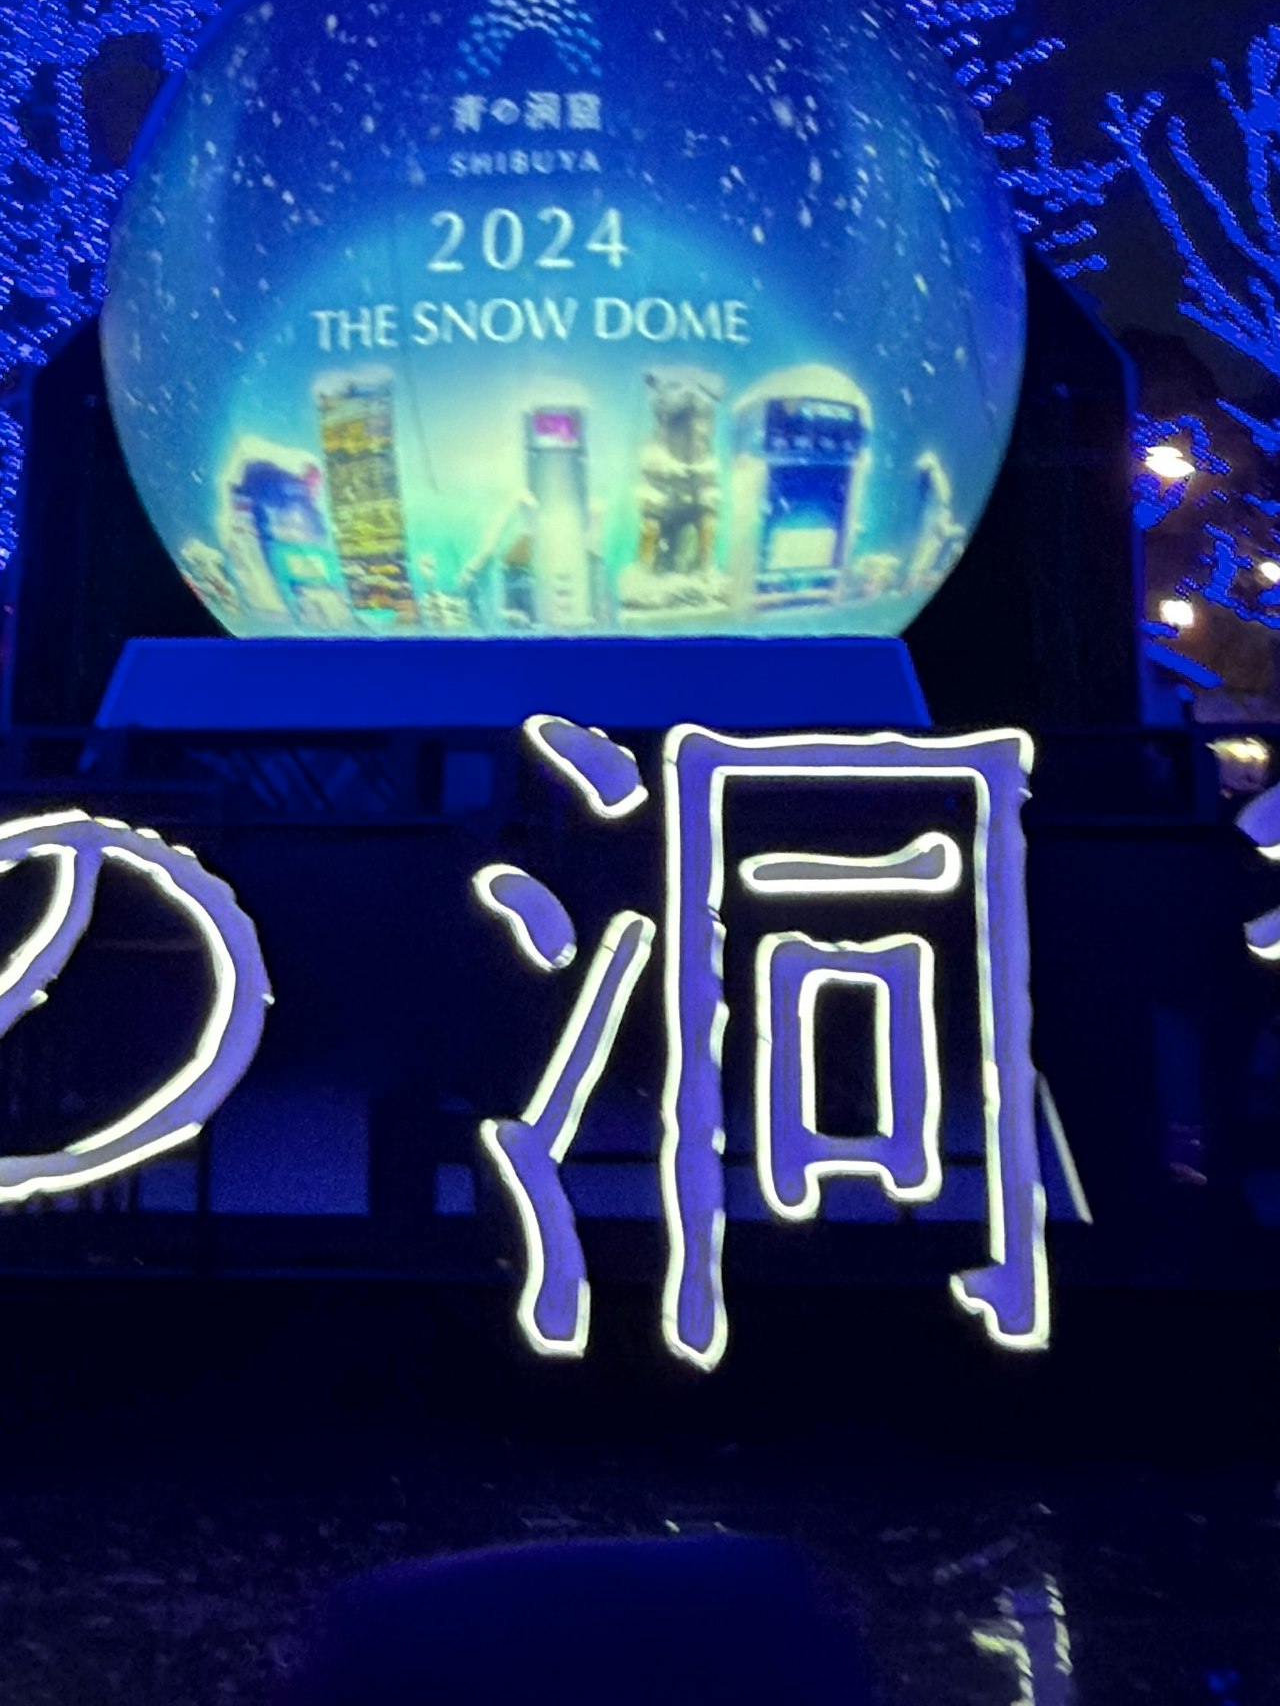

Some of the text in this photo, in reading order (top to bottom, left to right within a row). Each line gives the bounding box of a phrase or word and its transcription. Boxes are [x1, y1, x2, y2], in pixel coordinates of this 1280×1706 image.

[449, 149, 601, 178] SHIBUYA
[426, 206, 629, 272] 2024
[310, 297, 751, 351] THE SNOW DOME
